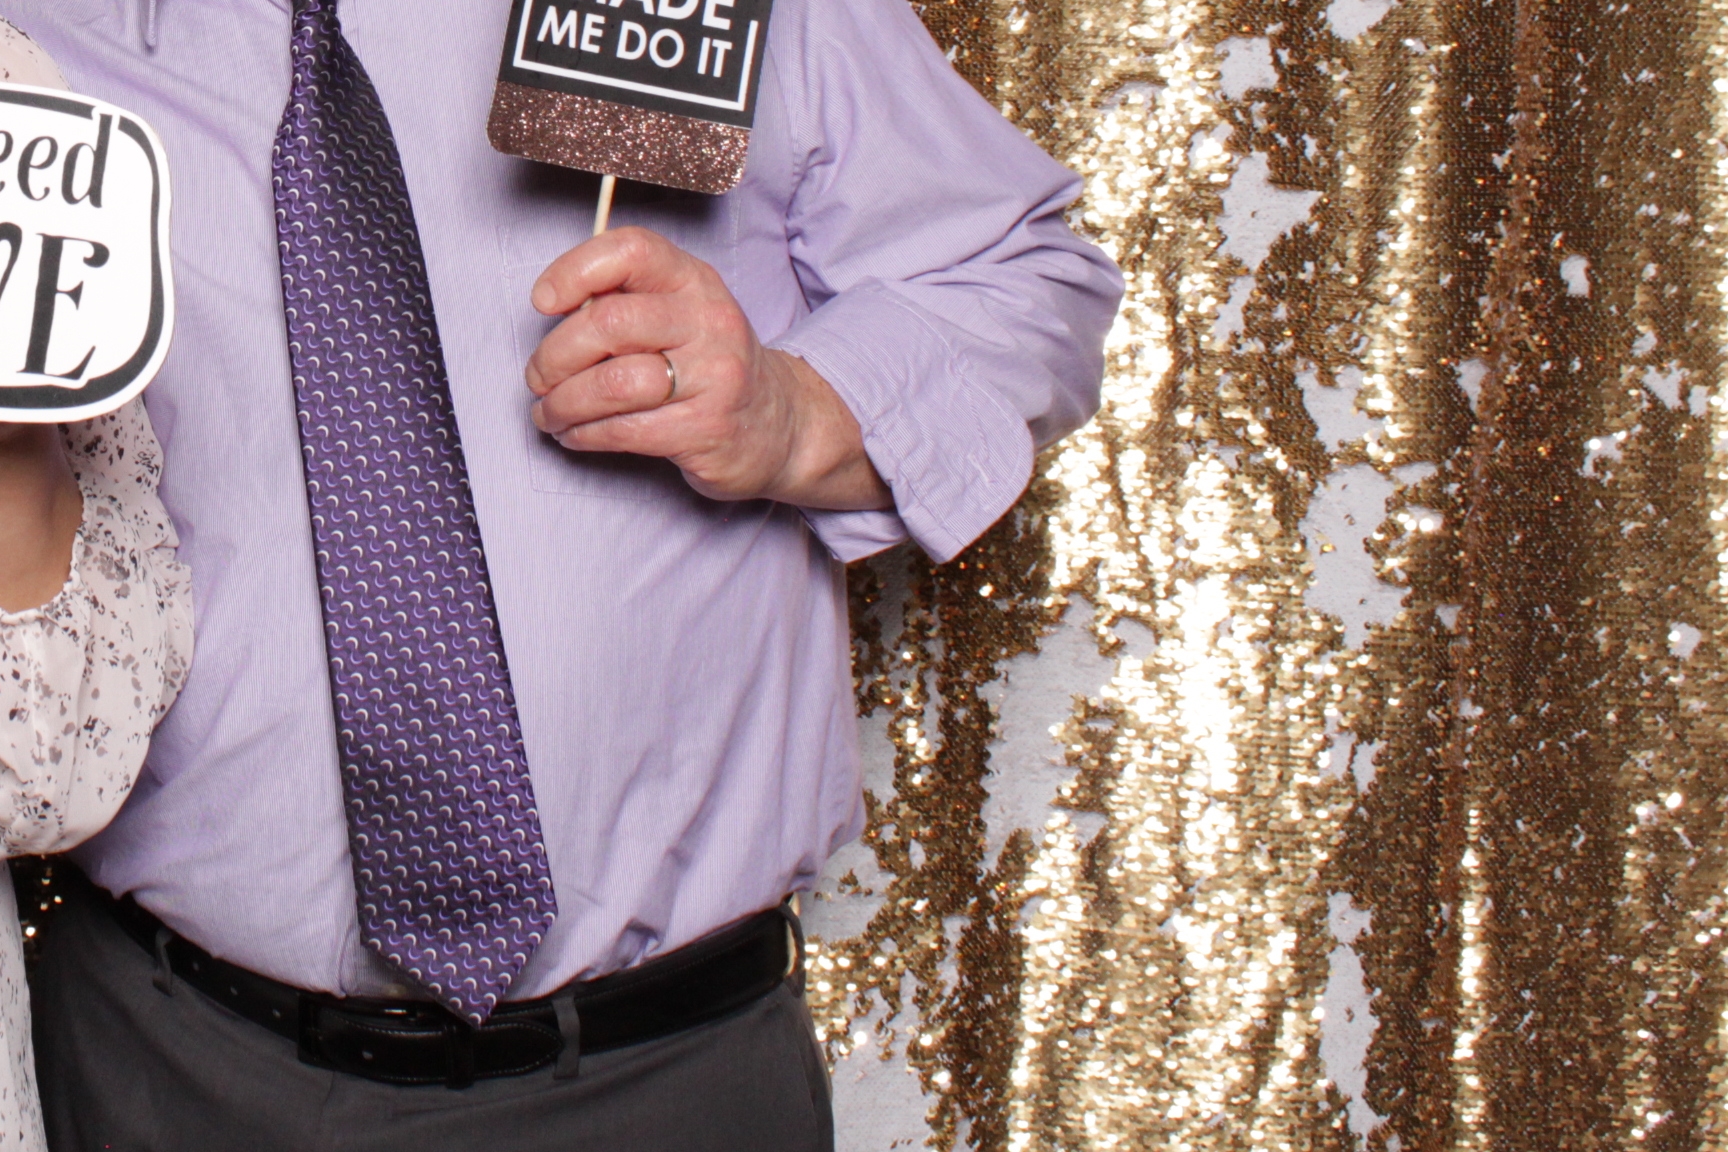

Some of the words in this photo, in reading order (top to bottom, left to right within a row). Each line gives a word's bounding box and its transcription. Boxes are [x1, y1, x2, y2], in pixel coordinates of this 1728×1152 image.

[537, 5, 605, 53] ME
[616, 20, 684, 68] DO
[697, 37, 732, 78] IT
